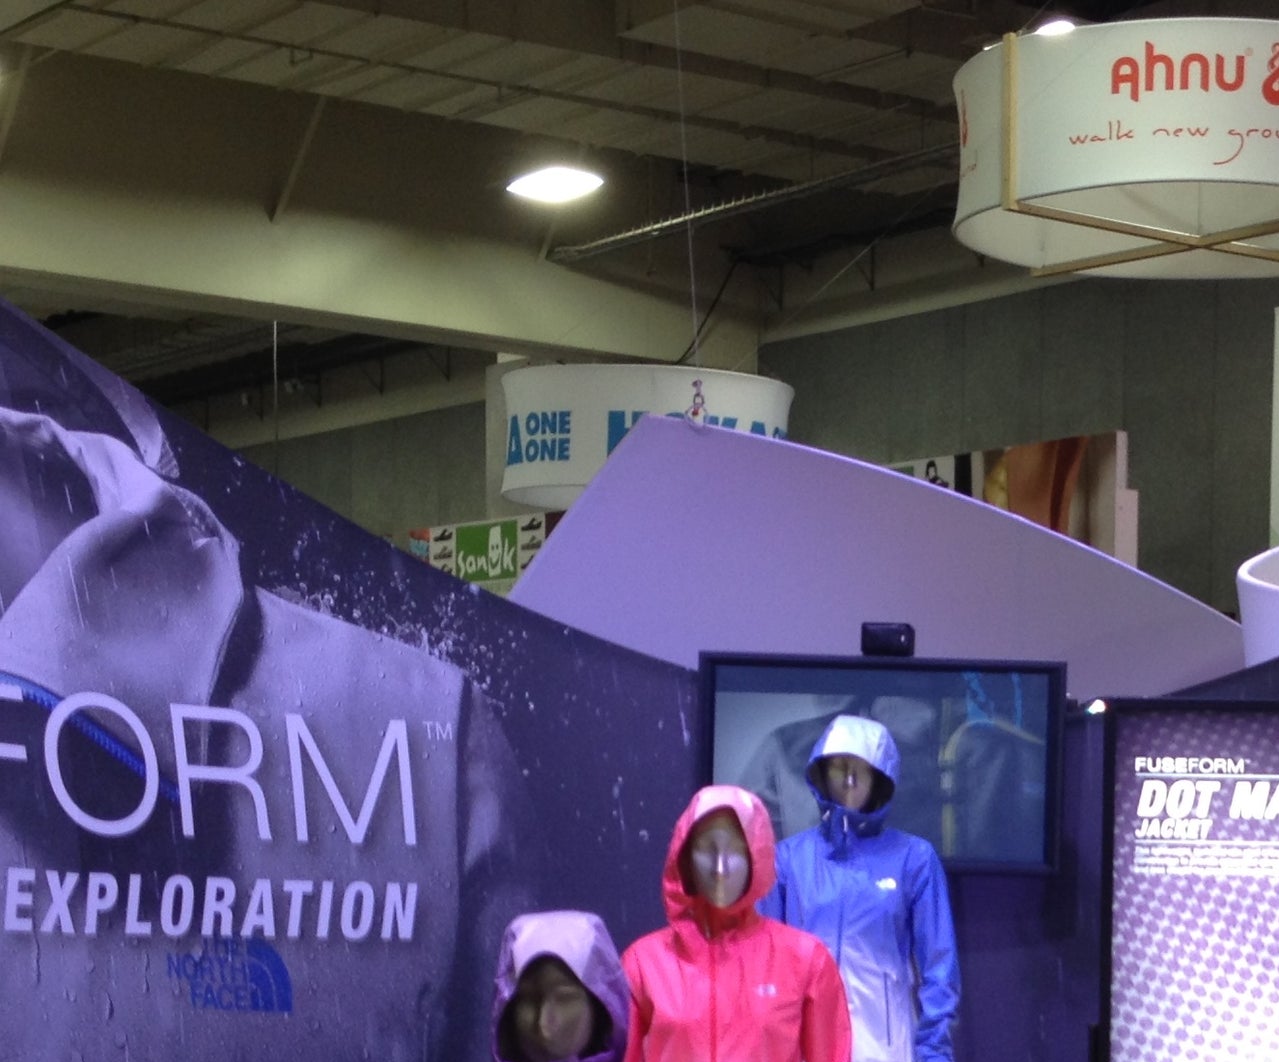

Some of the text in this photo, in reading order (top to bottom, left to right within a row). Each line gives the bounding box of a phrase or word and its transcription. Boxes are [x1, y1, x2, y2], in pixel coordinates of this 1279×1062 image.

[1068, 120, 1135, 145] walk
[1152, 126, 1209, 138] new
[525, 411, 571, 435] ONE
[525, 437, 571, 462] ONE
[1137, 780, 1221, 818] DOT
[1135, 819, 1213, 839] JACKET
[4, 867, 418, 942] EXPLORATION
[166, 952, 248, 984] NORTH
[190, 984, 253, 1011] FACE
